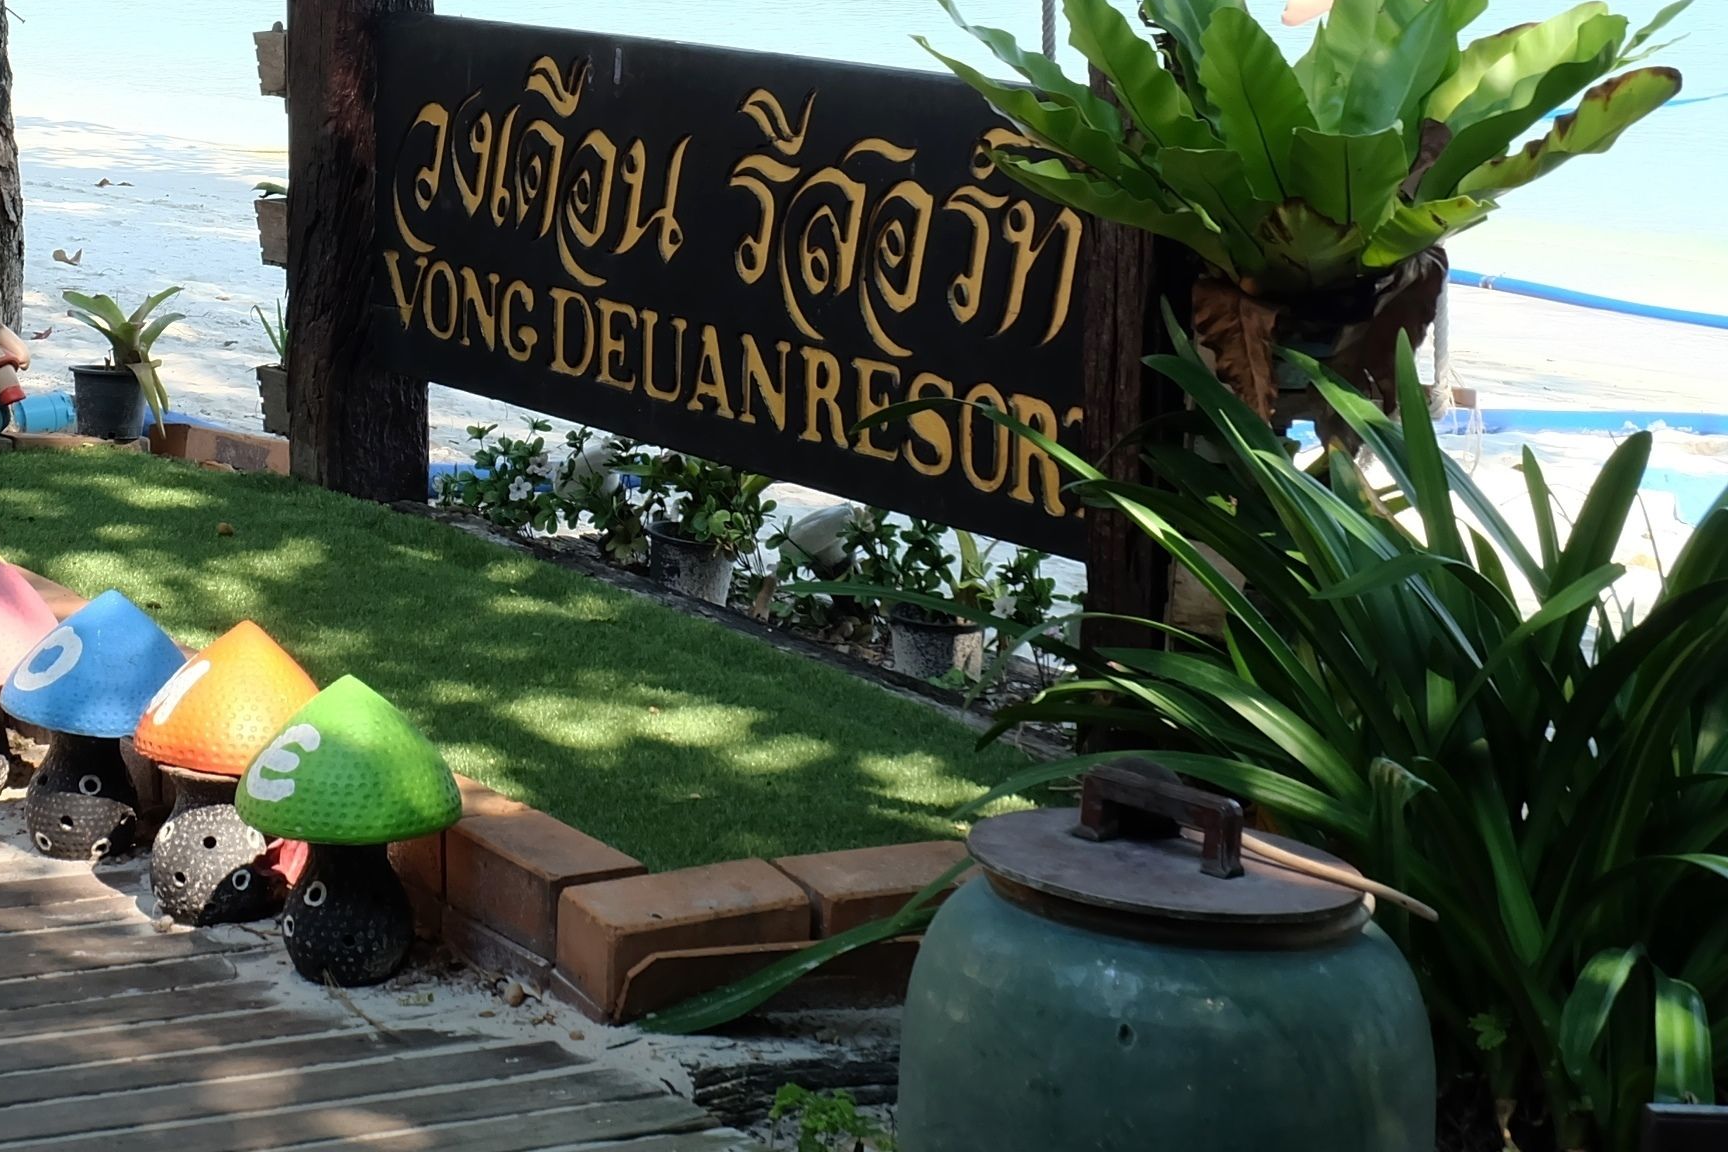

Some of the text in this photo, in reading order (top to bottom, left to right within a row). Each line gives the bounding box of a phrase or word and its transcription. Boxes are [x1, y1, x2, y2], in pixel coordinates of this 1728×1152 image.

[382, 250, 1085, 518] VONG DEUAN RESOR
